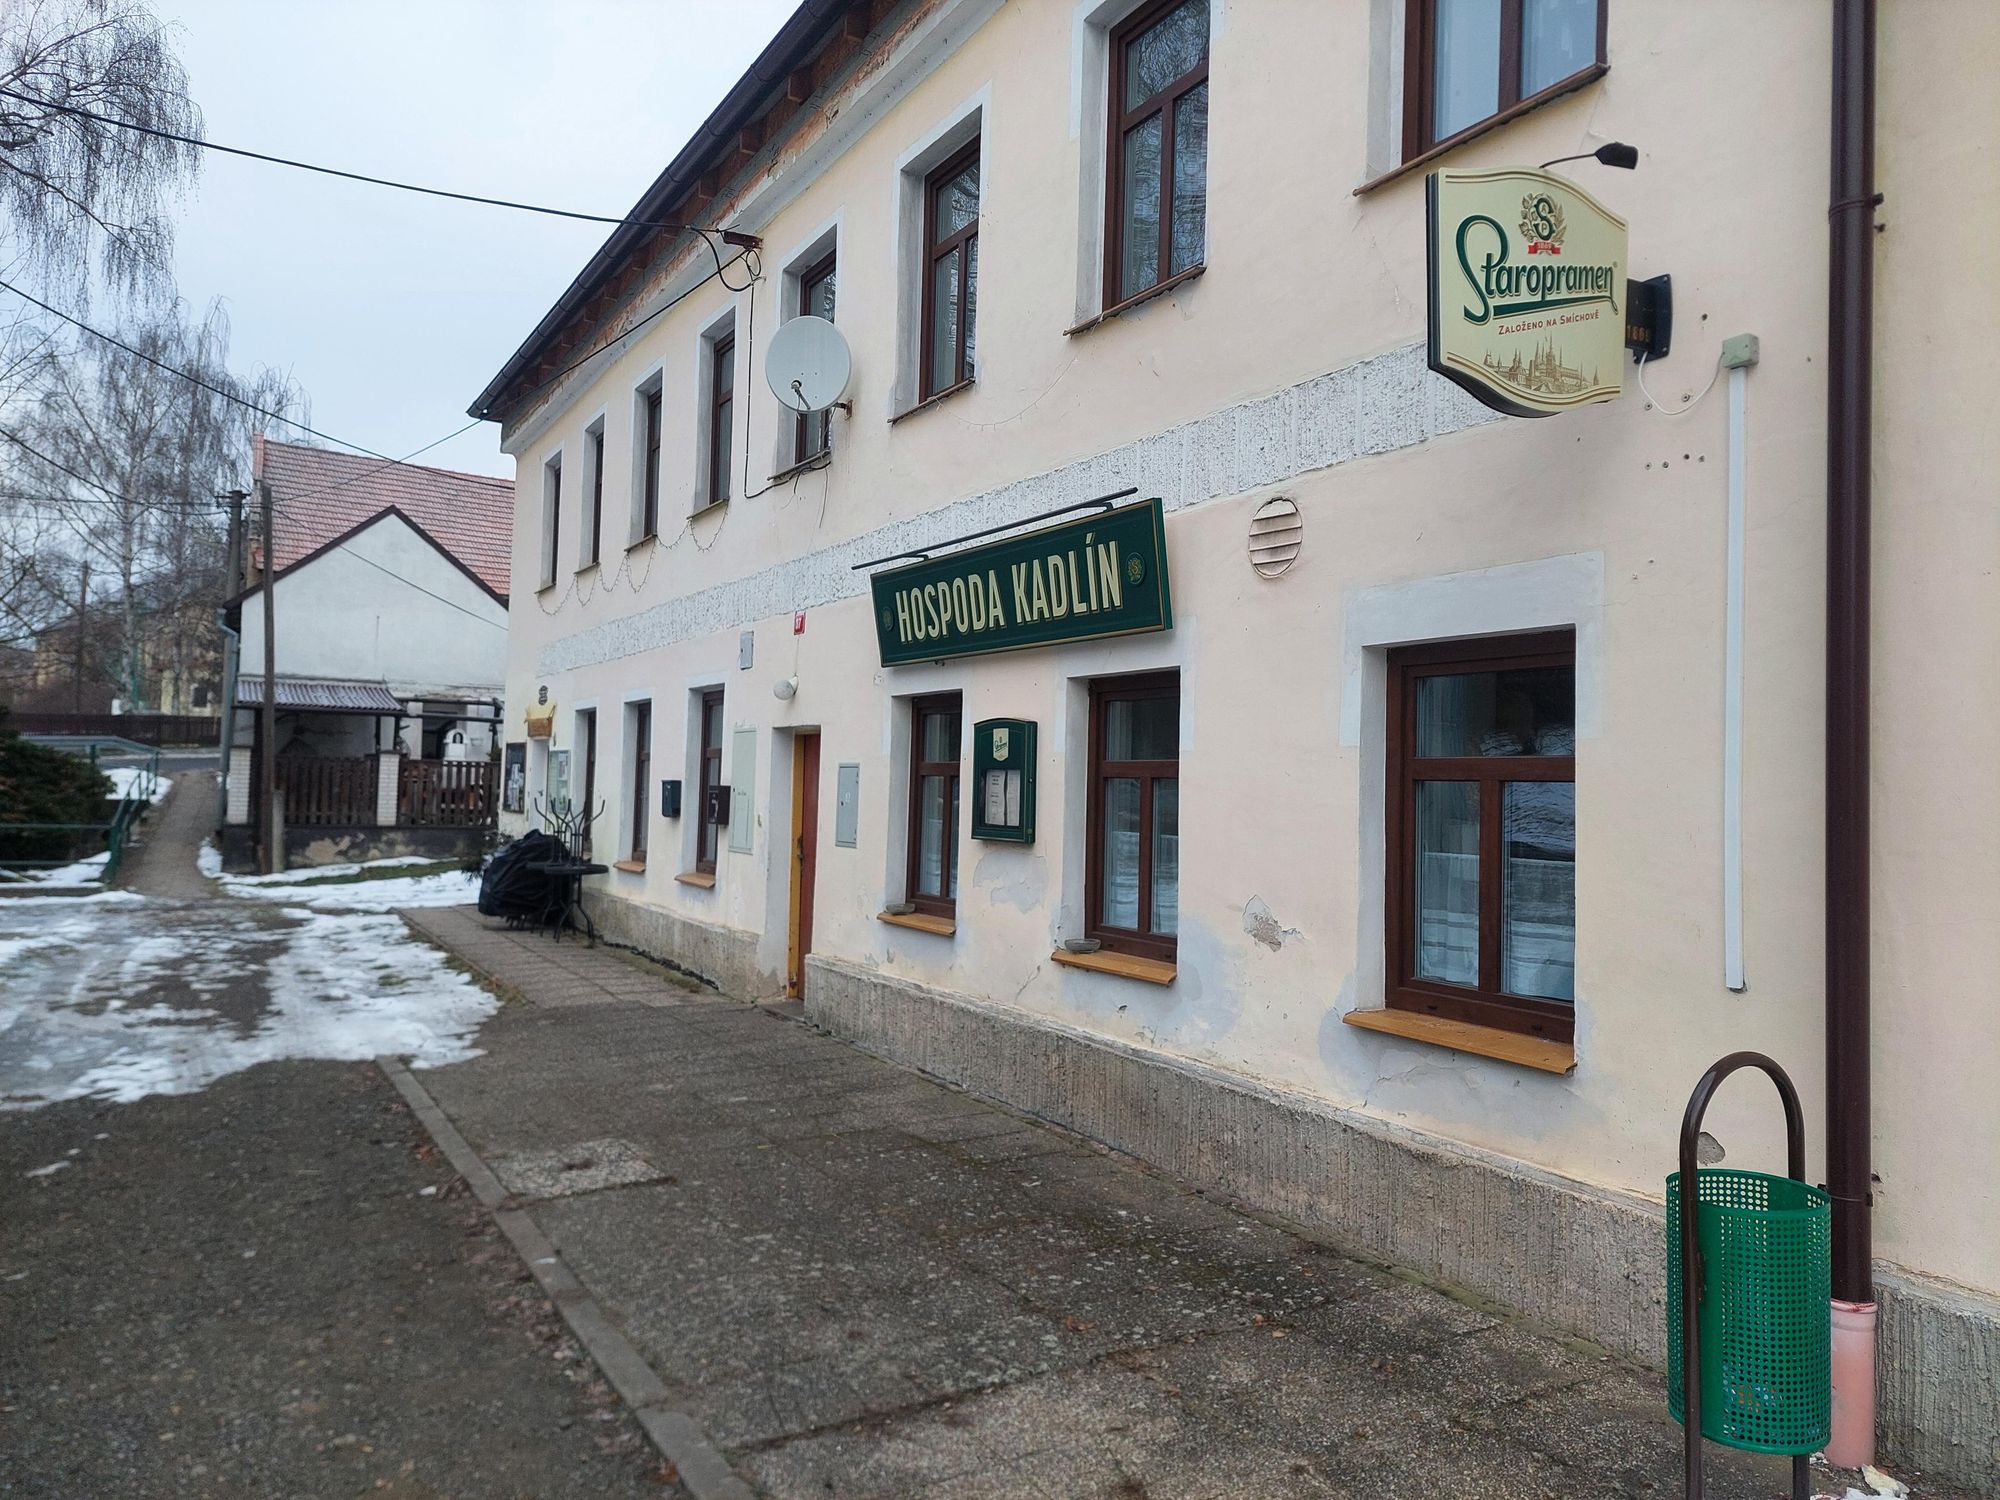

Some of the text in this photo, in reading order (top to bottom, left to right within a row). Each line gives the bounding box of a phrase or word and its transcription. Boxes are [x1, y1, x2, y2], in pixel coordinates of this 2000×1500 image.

[1455, 214, 1618, 326] Staropramen
[1546, 316, 1558, 327] NA
[895, 533, 1122, 643] HOSPODA KADLÍN
